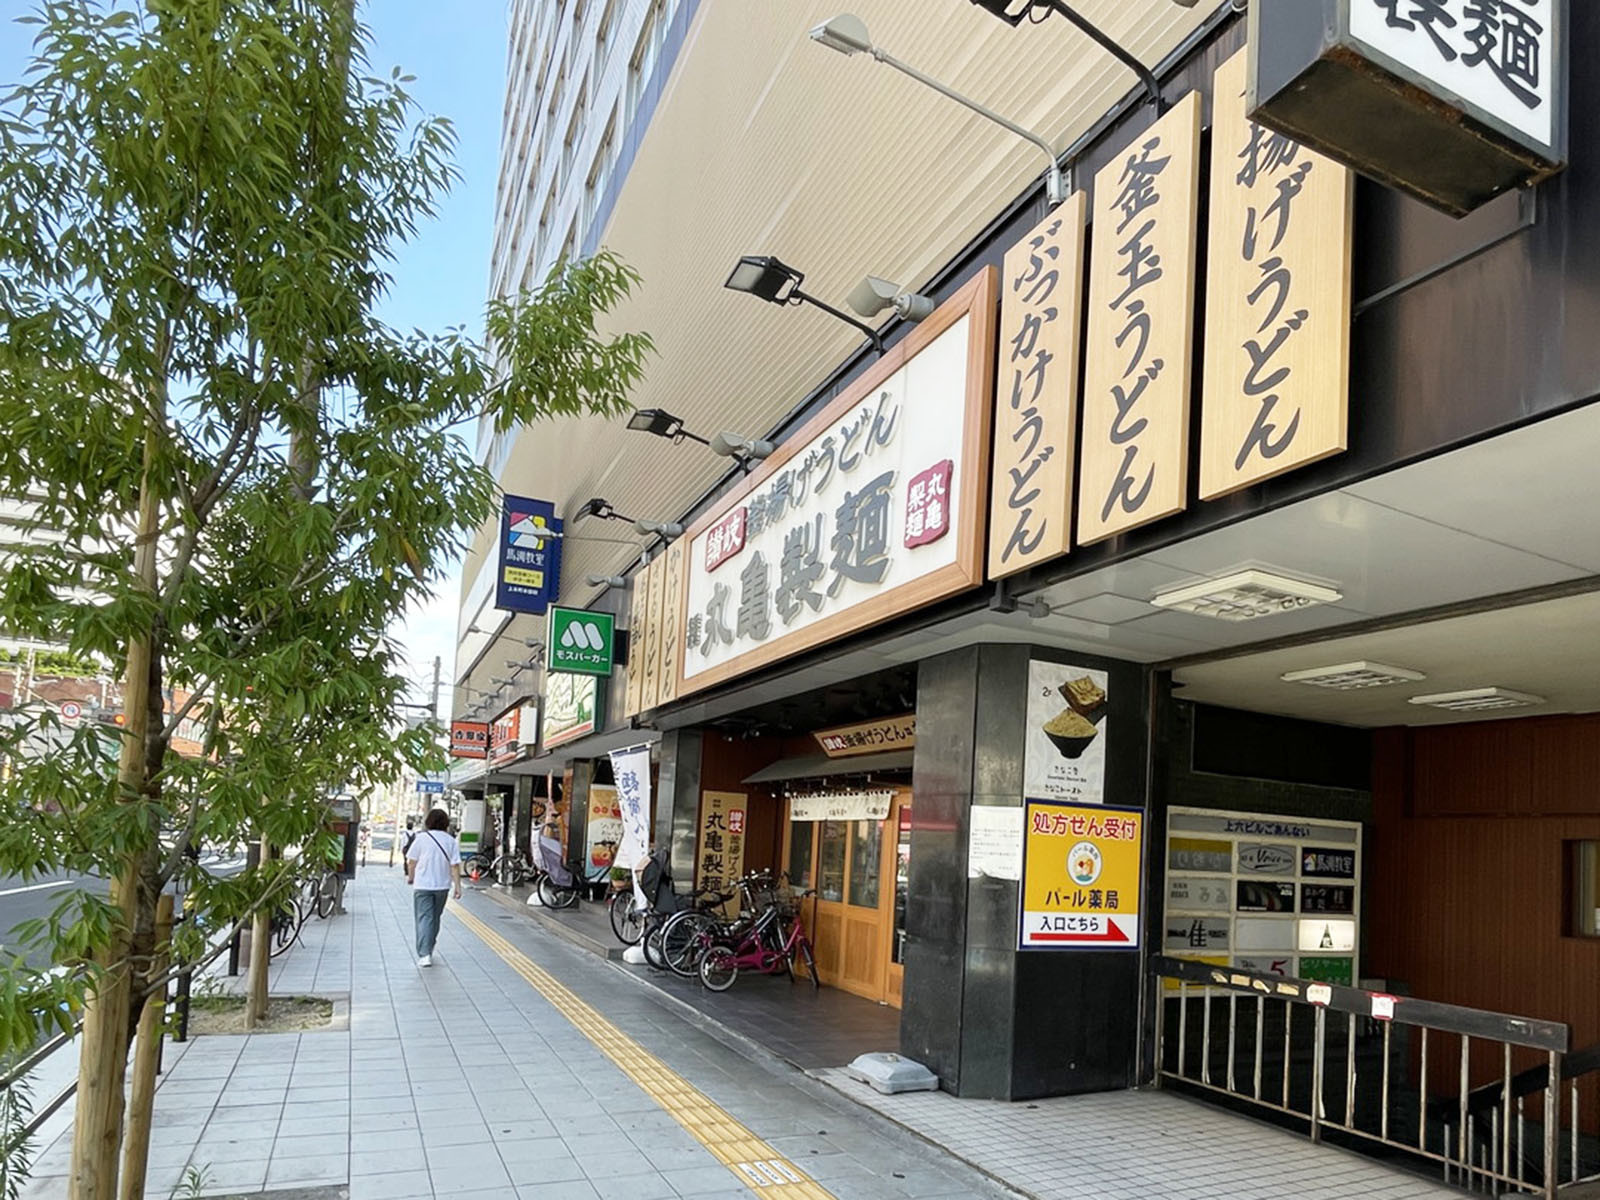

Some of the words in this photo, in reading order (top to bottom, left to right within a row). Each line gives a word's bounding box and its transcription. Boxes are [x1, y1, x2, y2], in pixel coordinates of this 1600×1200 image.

[1101, 136, 1172, 523] 釜玉うどん
[1235, 122, 1313, 471] 揚げうどん
[1001, 219, 1063, 564] ぶっかけうどん
[746, 391, 903, 544] 釜揚げうどん
[700, 470, 900, 658] 丸亀製麺
[706, 514, 742, 567] 讃岐
[556, 650, 608, 664] モスバーガー
[700, 811, 726, 893] 丸亀製麺
[1033, 812, 1137, 840] 処方せん受付
[1040, 916, 1100, 932] 入口こちら
[1045, 888, 1119, 910] パール薬局
